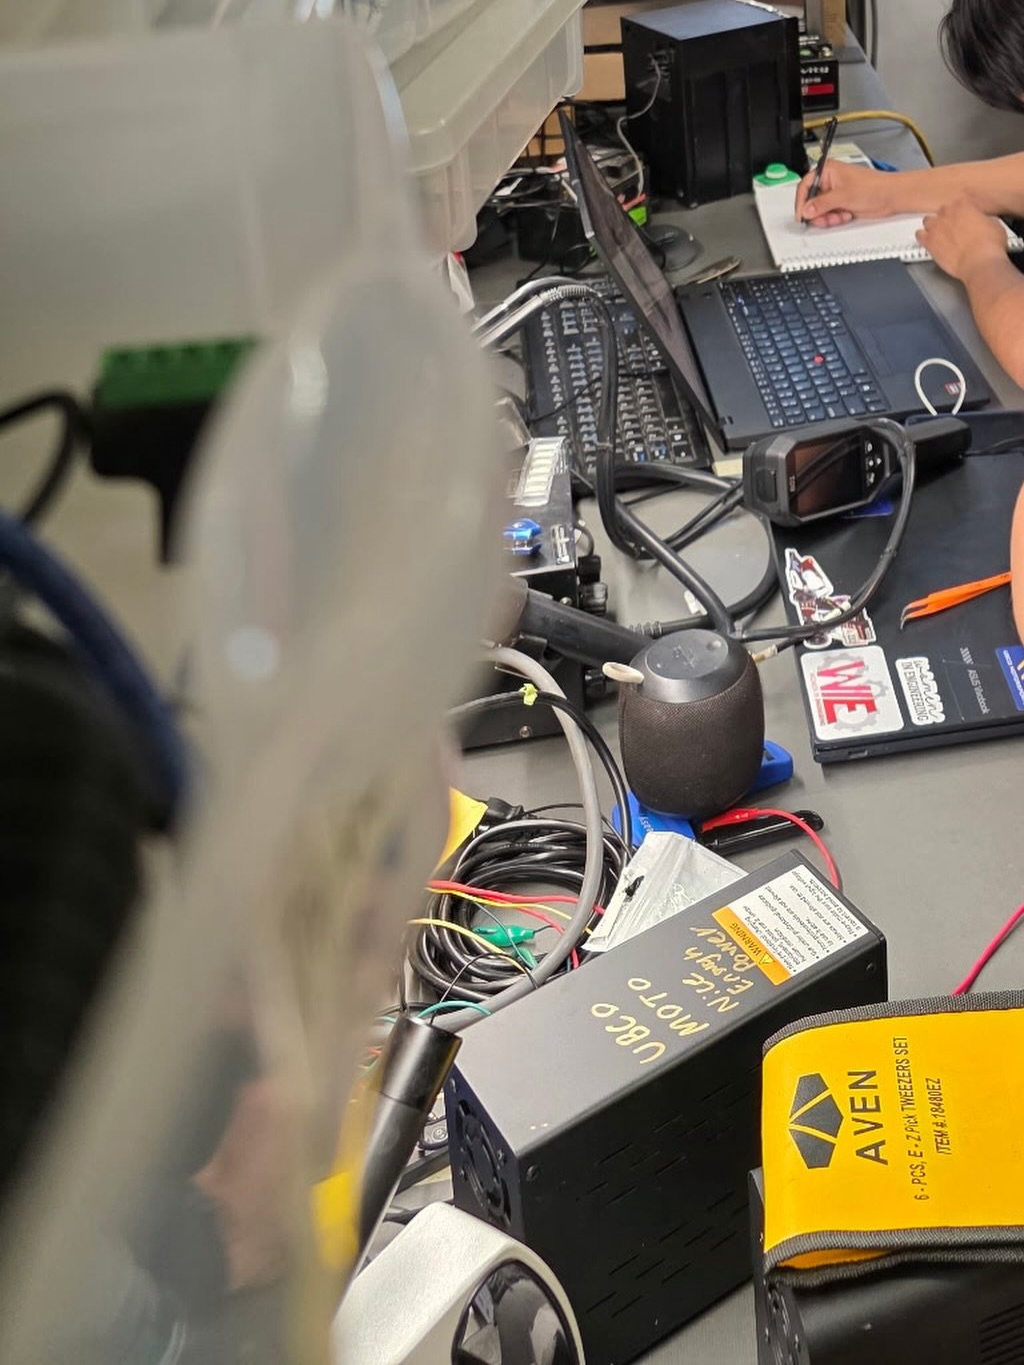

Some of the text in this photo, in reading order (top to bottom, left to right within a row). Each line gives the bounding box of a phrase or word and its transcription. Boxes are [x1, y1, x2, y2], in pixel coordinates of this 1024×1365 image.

[903, 670, 929, 721] ENGINEERING
[728, 921, 763, 956] WARNING
[628, 977, 710, 1036] MOTO
[591, 1002, 666, 1064] UBCO
[893, 1037, 909, 1056] SET
[895, 1058, 916, 1111] TWEEZERS
[847, 1069, 889, 1166] AVEN
[933, 1129, 952, 1155] ITEM
[909, 1161, 928, 1185] PCS,
